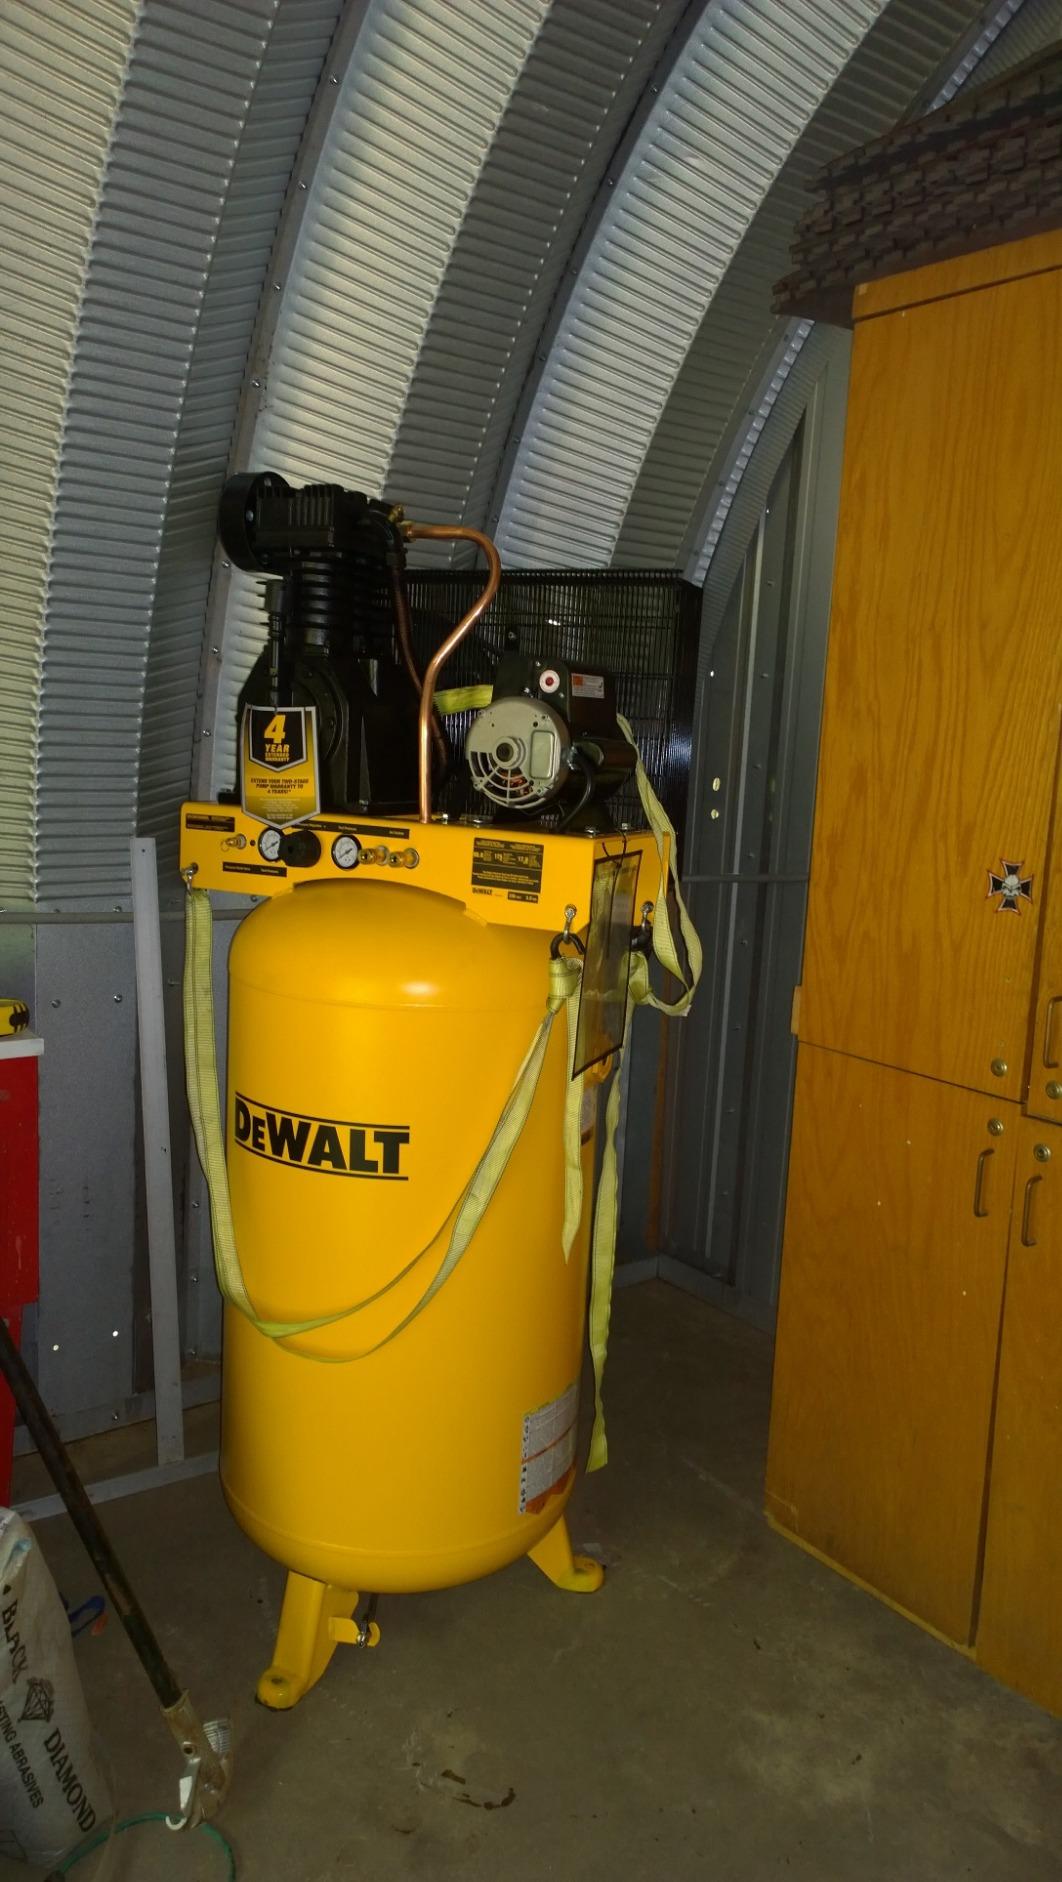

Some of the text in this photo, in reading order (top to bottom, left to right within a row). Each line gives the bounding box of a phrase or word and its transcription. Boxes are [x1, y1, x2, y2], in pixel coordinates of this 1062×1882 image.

[263, 713, 287, 744] 4
[265, 743, 290, 753] YEAR
[1, 1598, 97, 1833] BLACK DIAMOND
[9, 1742, 45, 1809] ABRASIVES
